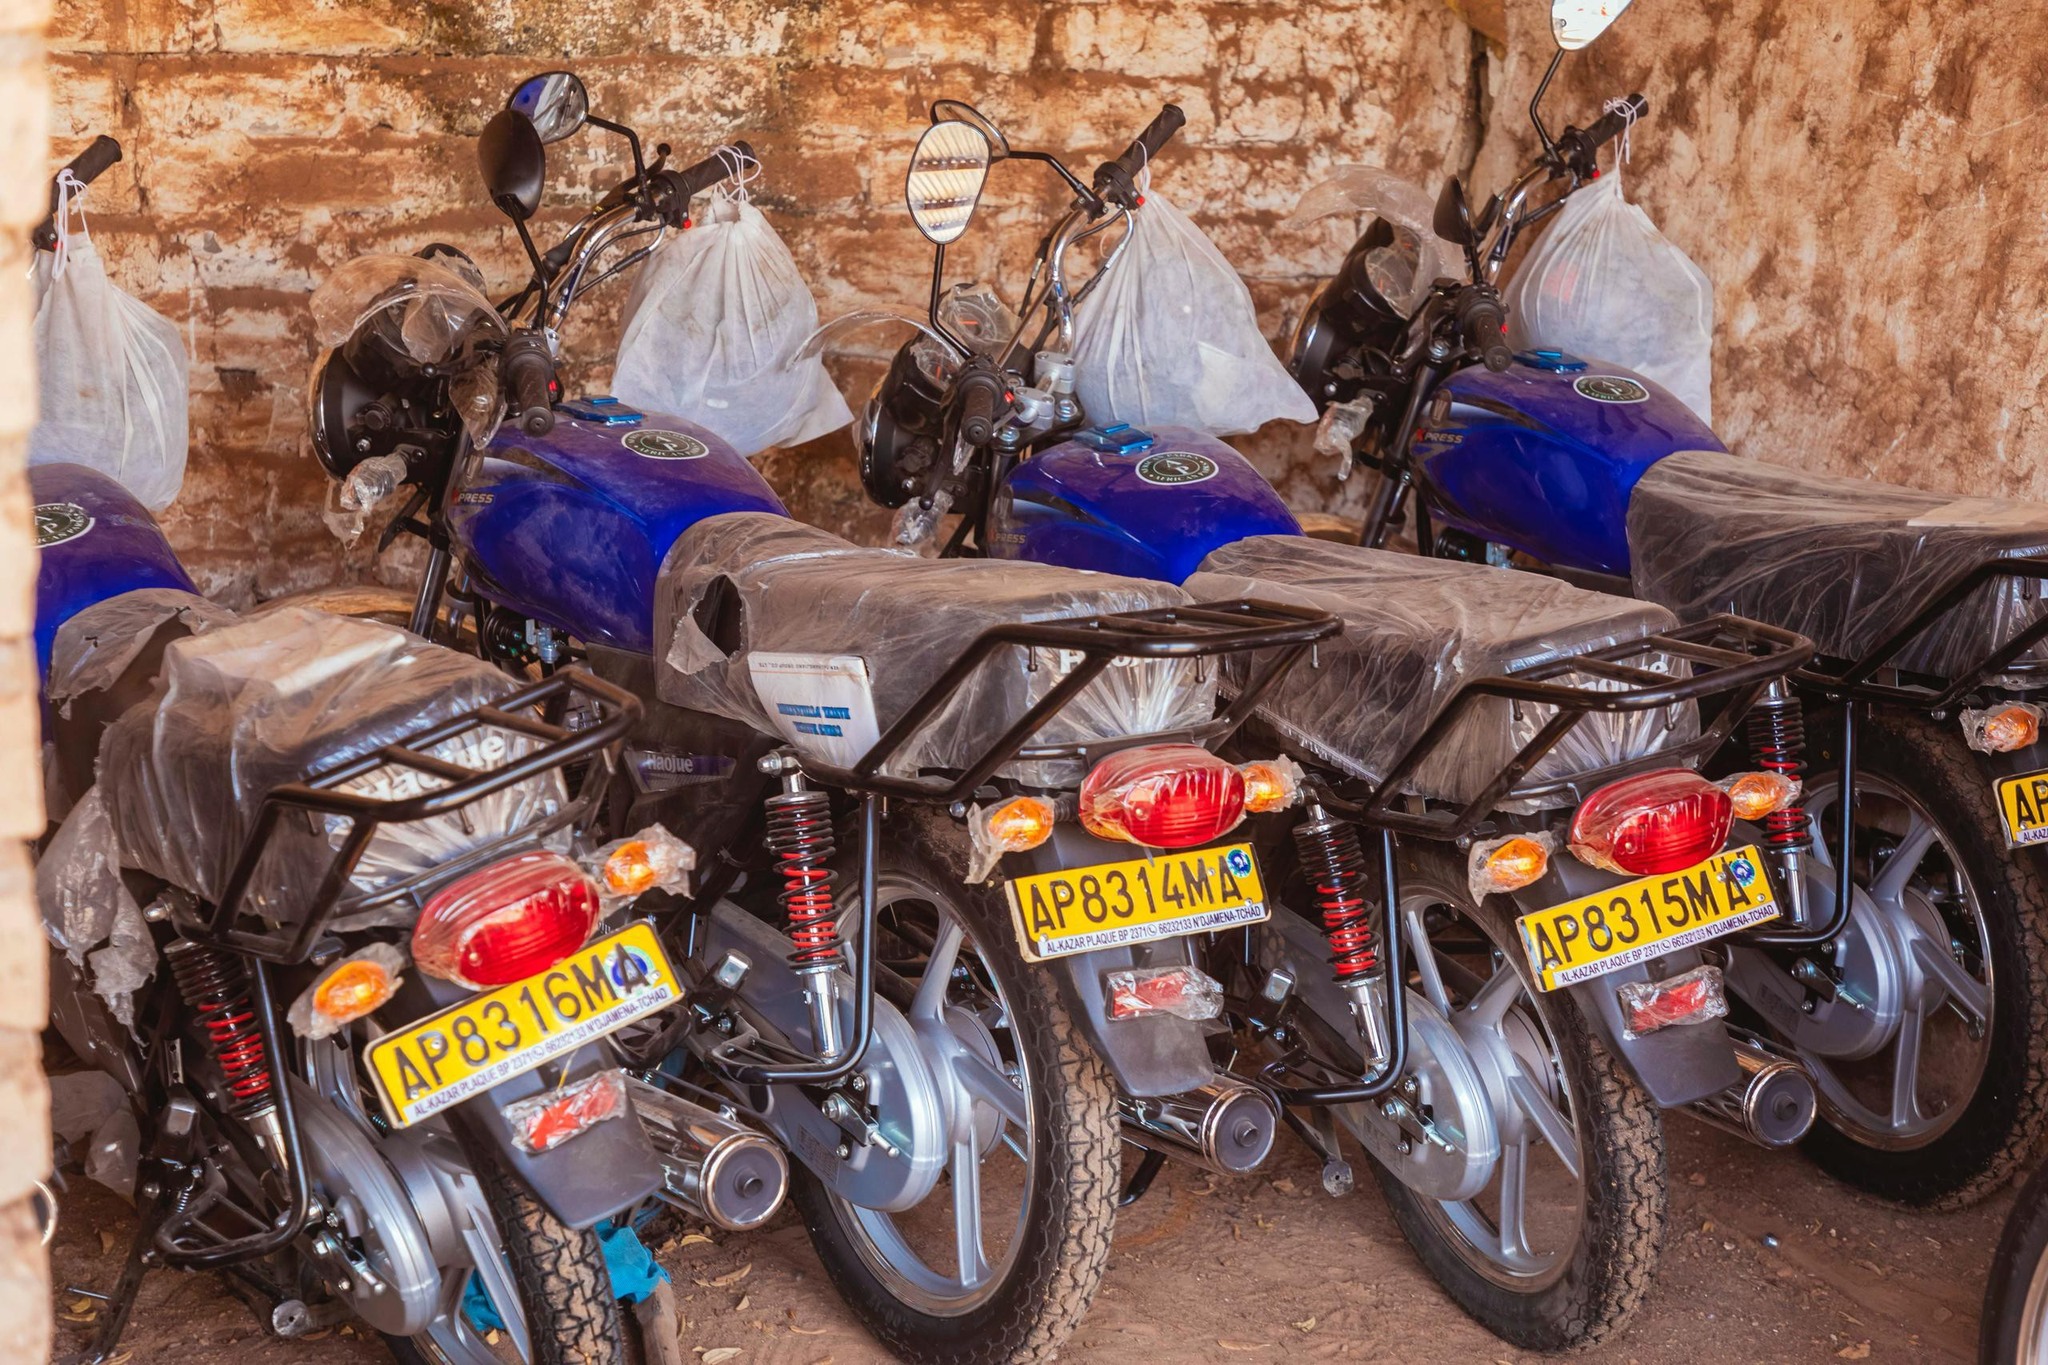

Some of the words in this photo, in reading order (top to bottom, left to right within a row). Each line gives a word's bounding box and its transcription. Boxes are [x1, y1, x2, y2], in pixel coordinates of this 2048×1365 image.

[647, 753, 694, 773] Haojue
[2023, 827, 2048, 842] AL-KAZ
[1030, 855, 1243, 933] AP8314MA
[1047, 935, 1086, 953] AL-KAZAR
[1086, 931, 1118, 948] PLAQUE
[1118, 929, 1129, 942] BP
[1130, 926, 1147, 939] 2371
[1158, 919, 1192, 935] 66232133
[1193, 906, 1261, 927] N'DJAMENA-TCHAD
[1535, 862, 1752, 971] AP8315MA
[1561, 963, 1600, 982] AL-KAZAR
[1600, 951, 1631, 971] PLAQUE
[1632, 948, 1643, 961] BP
[1644, 944, 1661, 958] 2371
[1671, 929, 1706, 948] 66232133
[1706, 904, 1775, 937] N'DJAMENA-TCHAD
[394, 942, 650, 1100] AP8316MA
[413, 1086, 460, 1116] AL-KAZAR
[461, 1067, 498, 1096] PLAQUE
[497, 1061, 510, 1079] BP
[511, 1050, 533, 1070] 2371
